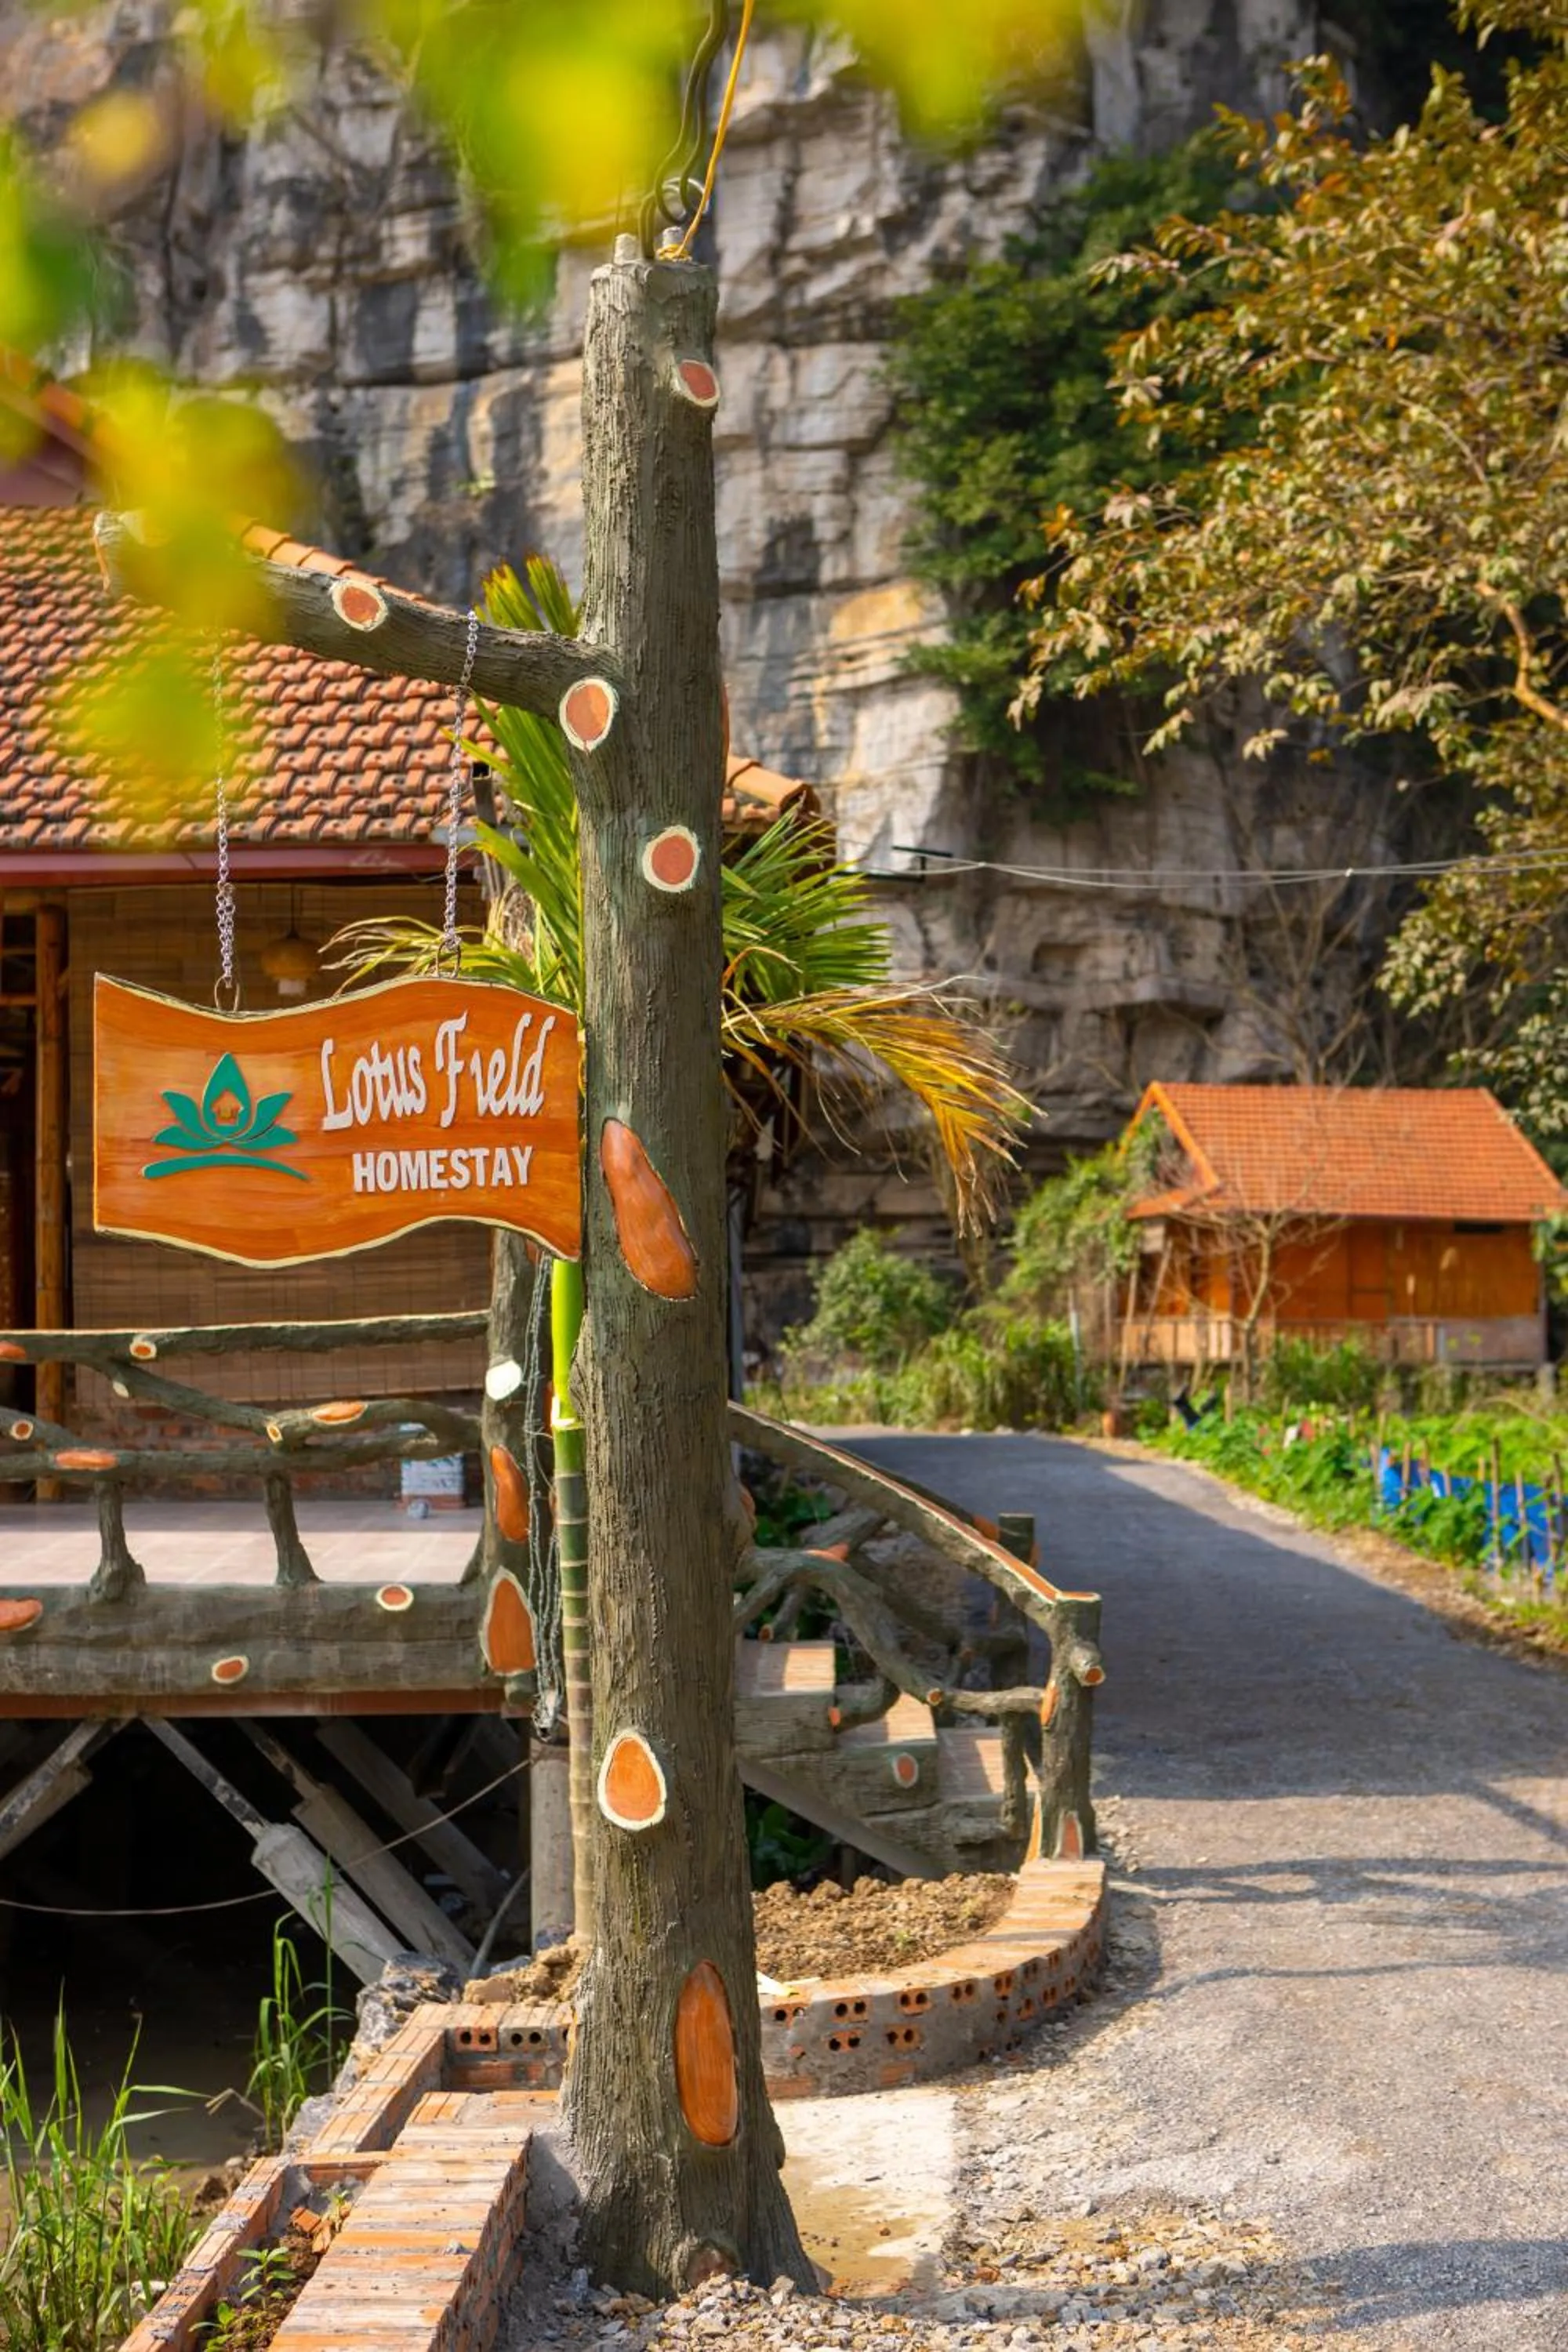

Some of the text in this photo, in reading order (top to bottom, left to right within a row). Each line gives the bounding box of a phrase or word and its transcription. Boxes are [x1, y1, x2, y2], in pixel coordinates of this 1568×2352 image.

[321, 1011, 556, 1131] Lotus Field
[352, 1145, 533, 1192] HOMESTAY
